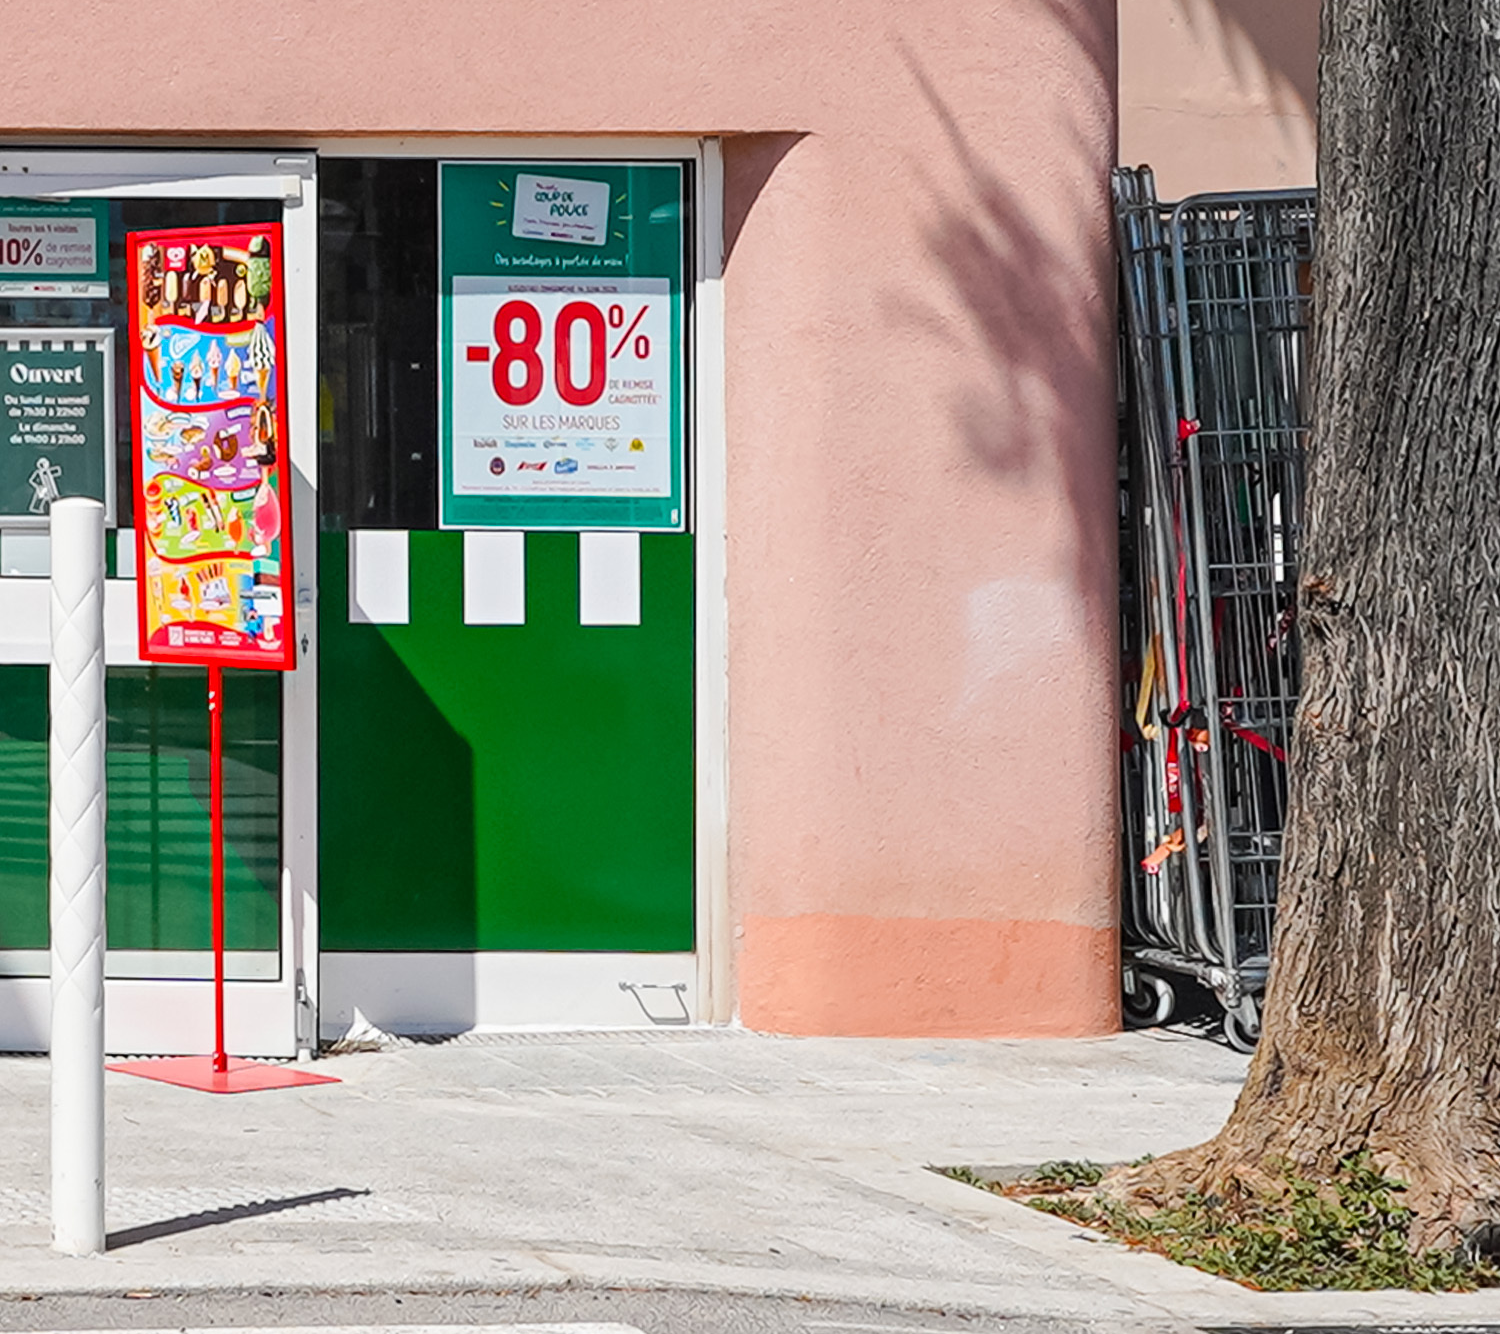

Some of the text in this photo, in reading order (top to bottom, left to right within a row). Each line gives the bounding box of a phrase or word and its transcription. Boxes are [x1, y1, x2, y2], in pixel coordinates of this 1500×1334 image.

[466, 300, 650, 406] -80%
[10, 362, 84, 384] Ouvert
[502, 414, 620, 431] SUR LES MARQUES
